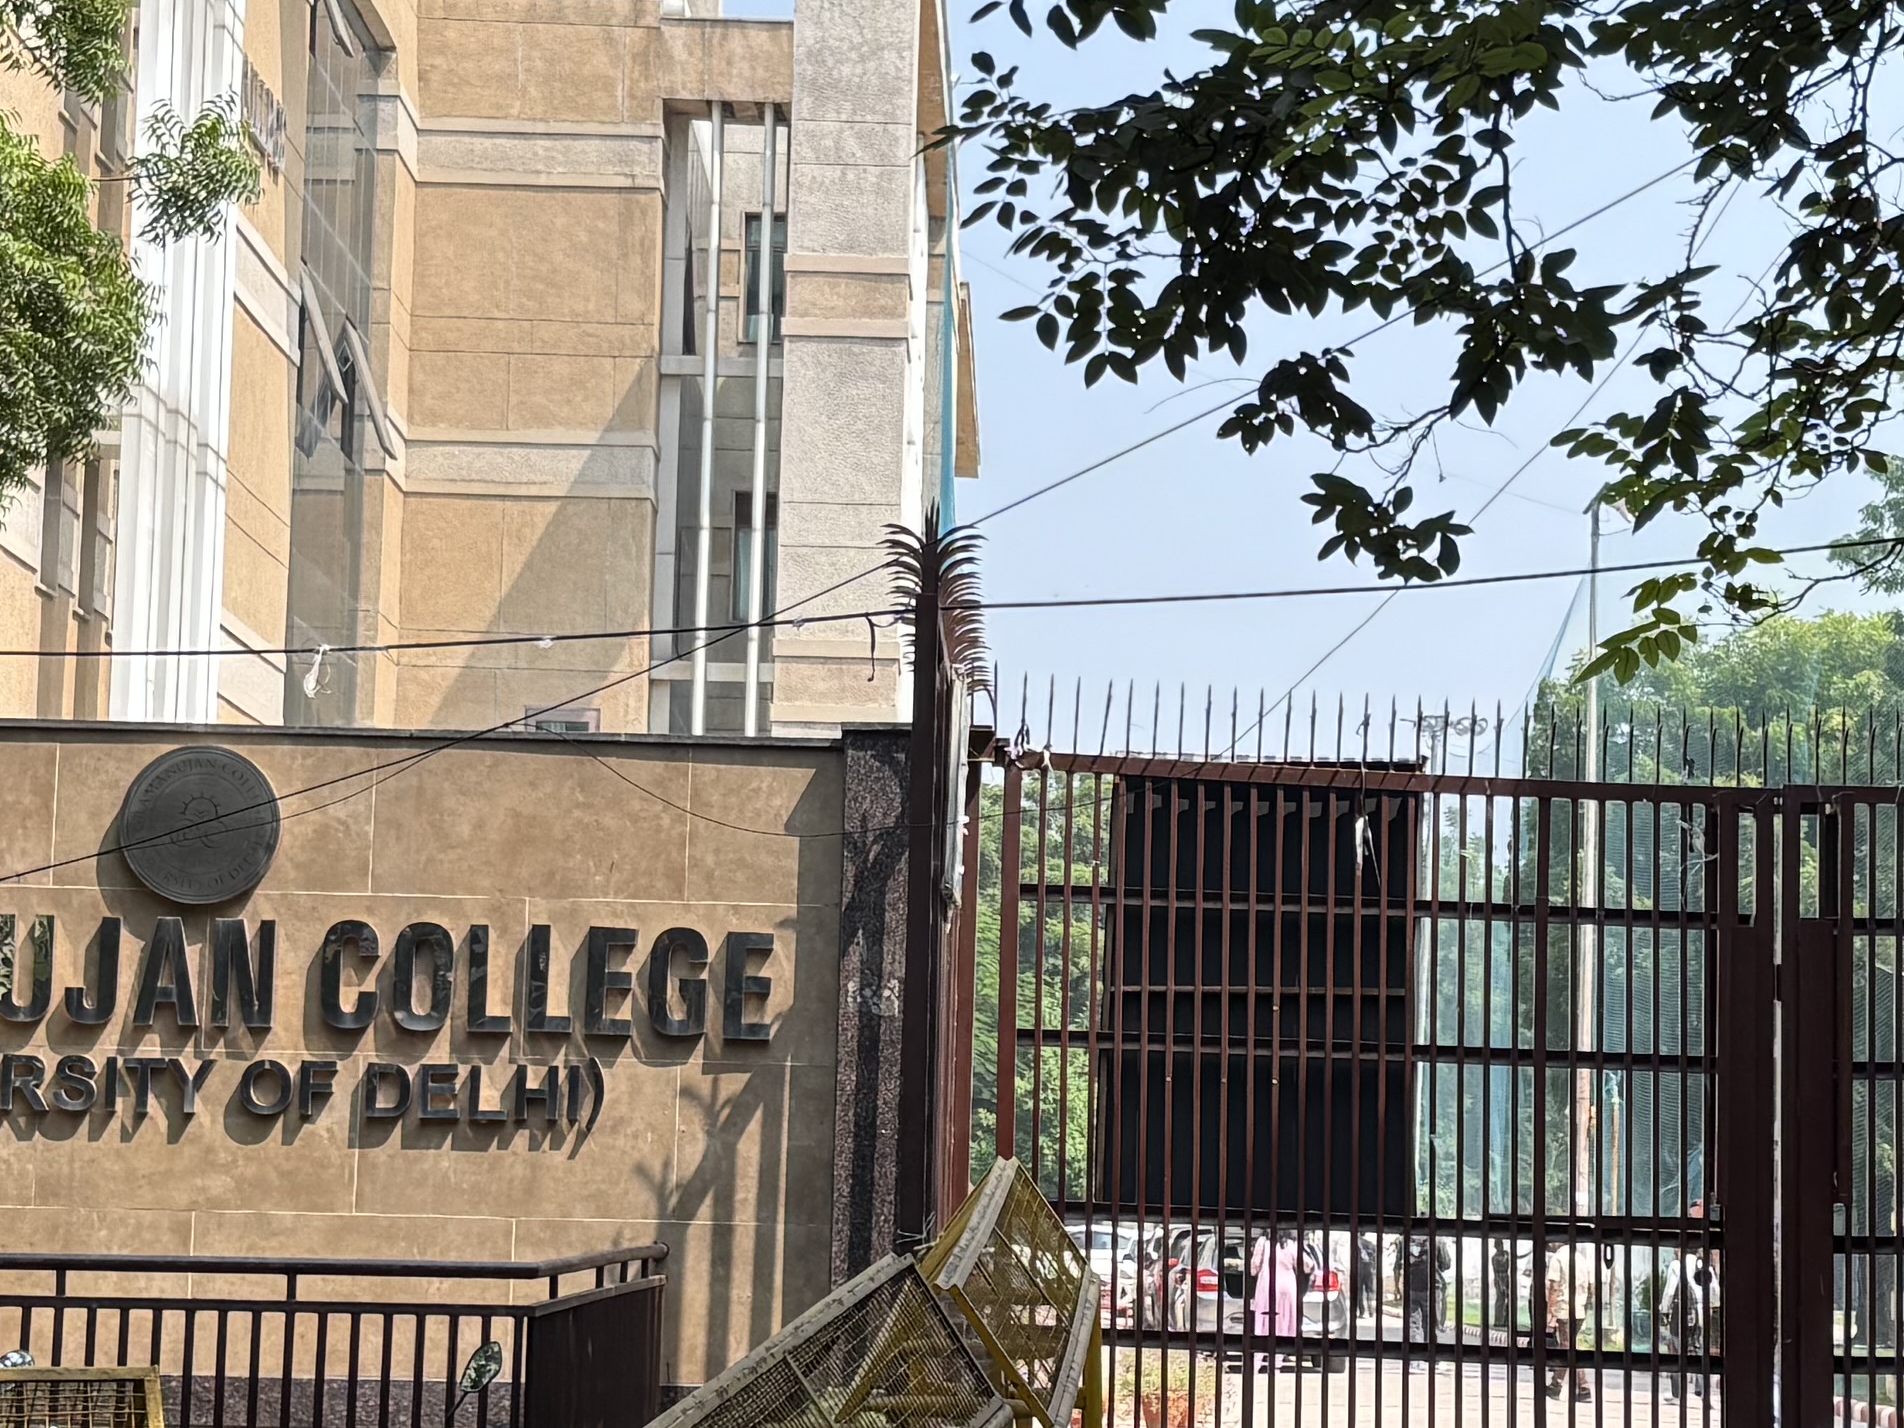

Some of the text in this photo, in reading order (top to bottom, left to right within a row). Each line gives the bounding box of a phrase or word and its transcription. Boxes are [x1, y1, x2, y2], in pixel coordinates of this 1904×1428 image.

[321, 920, 775, 1041] COLLEGE
[240, 1058, 339, 1117] OF
[365, 1056, 605, 1133] DELHI)
